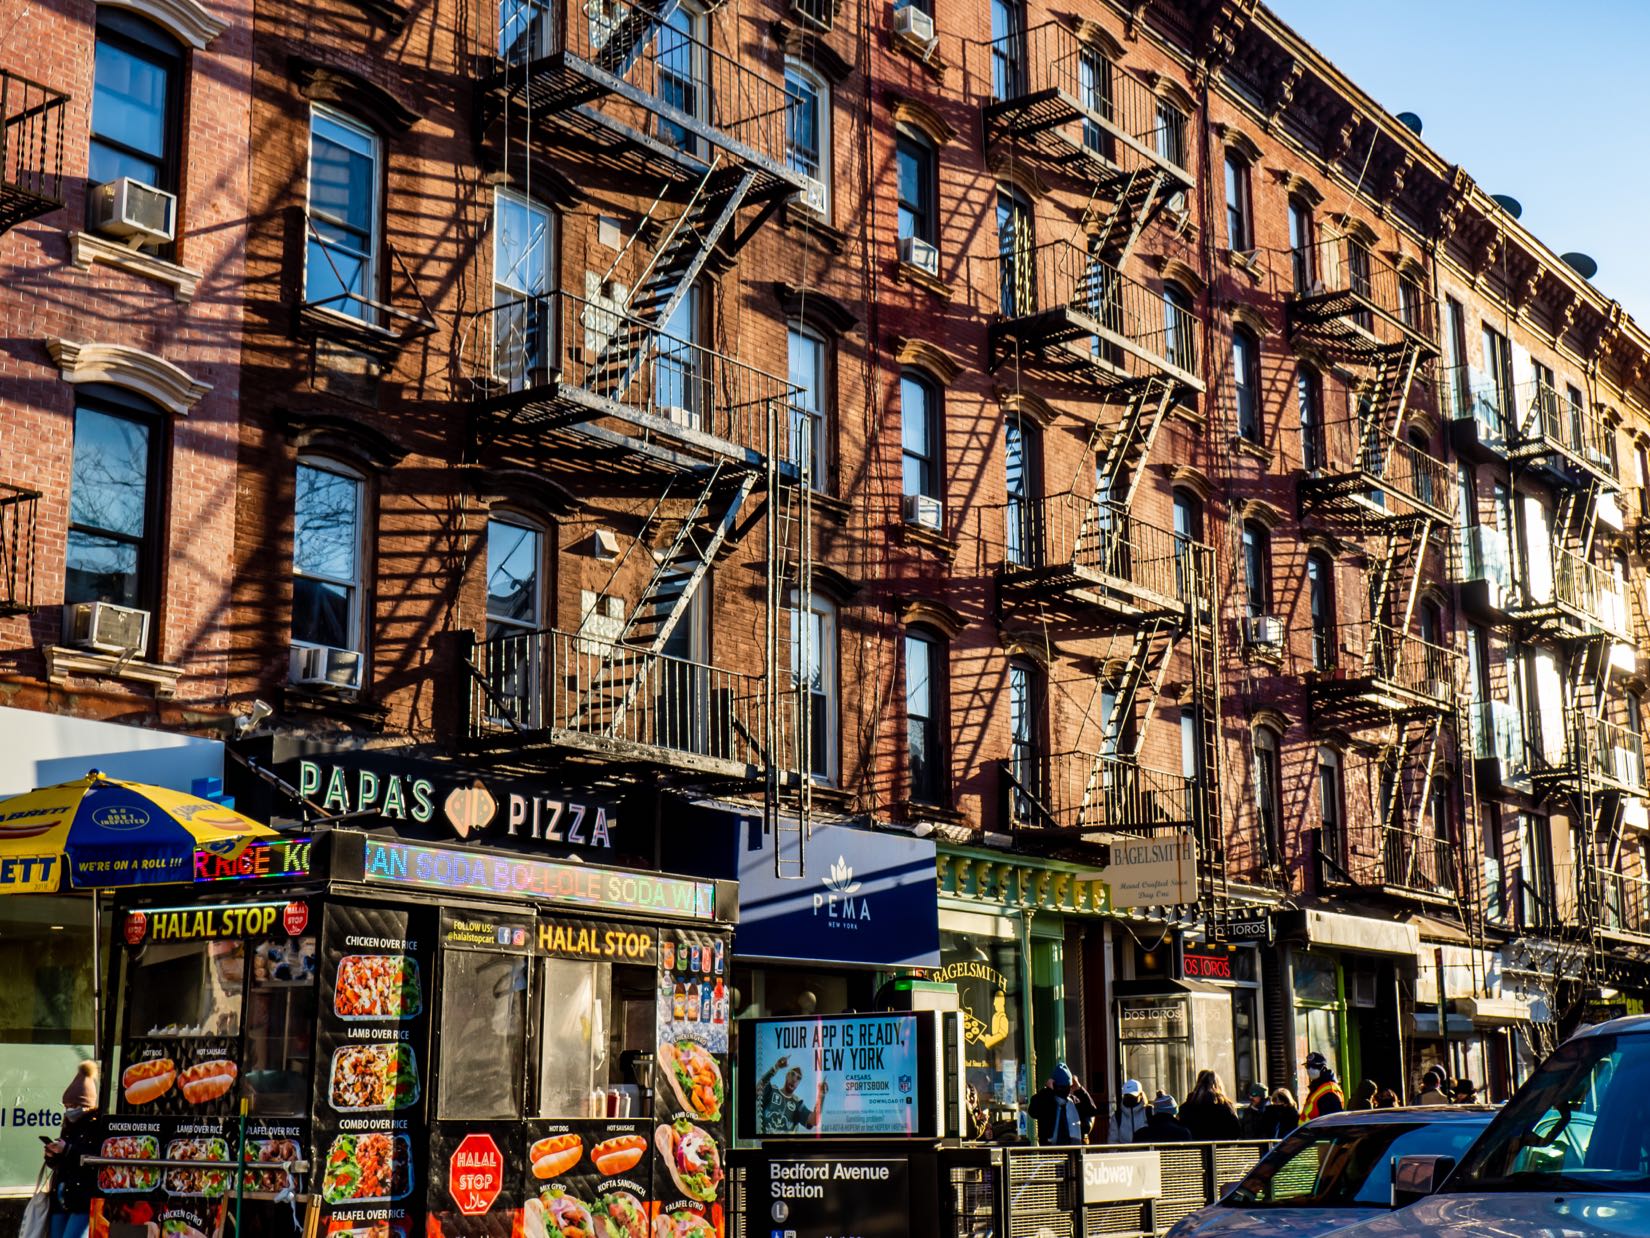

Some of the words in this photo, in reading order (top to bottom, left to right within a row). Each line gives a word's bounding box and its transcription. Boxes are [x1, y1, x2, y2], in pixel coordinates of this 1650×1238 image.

[301, 760, 435, 823] PAPA'S
[508, 793, 611, 848] PIZZA
[1114, 843, 1192, 866] BAGELSMITH
[78, 861, 110, 872] WE'RE
[114, 860, 128, 870] ON
[131, 859, 138, 869] A
[141, 859, 166, 869] ROLL
[416, 853, 487, 887] SODA
[608, 877, 666, 907] SODA
[813, 893, 871, 921] PEMA
[152, 911, 217, 939] HALAL
[221, 907, 277, 935] STOP
[287, 916, 304, 925] STOP
[453, 920, 481, 932] FOLLOW
[843, 922, 858, 930] YORK
[345, 936, 379, 948] CHICKEN
[380, 938, 400, 949] OVER
[401, 940, 418, 950] RICE
[538, 924, 601, 954] HALAL
[604, 931, 651, 957] STOP
[1184, 959, 1198, 975] OS
[1200, 957, 1231, 977] TOROS
[933, 962, 1008, 992] BAGELSMITH
[1124, 1010, 1146, 1021] DOS
[347, 1028, 370, 1039] LAMB
[372, 1029, 392, 1039] OVER
[775, 1026, 806, 1049] YOUR
[812, 1025, 836, 1048] APP
[842, 1025, 853, 1047] IS
[859, 1022, 905, 1047] READY,
[814, 1049, 843, 1071] NEW
[850, 1047, 884, 1071] YORK
[845, 1081, 889, 1091] SPORTSBOOK
[13, 1108, 62, 1127] Bette
[672, 1111, 685, 1120] LAMB
[686, 1111, 699, 1120] GYRO
[108, 1122, 131, 1132] CHICKEN
[132, 1123, 147, 1132] OVER
[148, 1123, 160, 1132] RICE
[177, 1124, 193, 1133] LAMB
[193, 1125, 209, 1134] OVER
[210, 1125, 223, 1134] RICE
[246, 1126, 268, 1135] ALAFEL
[268, 1127, 285, 1136] OVER
[286, 1127, 300, 1136] RICE
[339, 1119, 368, 1129] COMBO
[370, 1119, 391, 1129] OVER
[391, 1119, 408, 1129] RICE
[457, 1152, 497, 1167] HALAL
[770, 1163, 829, 1180] Bedford
[833, 1163, 889, 1180] Avenue
[1084, 1162, 1134, 1187] Subway
[459, 1174, 493, 1190] STOP
[539, 1184, 550, 1192] MIX
[551, 1183, 567, 1192] GYRO
[597, 1180, 617, 1193] KOFTA
[617, 1179, 647, 1197] SANDWICH
[770, 1181, 824, 1198] Station
[464, 1192, 488, 1209] حلال
[665, 1200, 688, 1213] FALAFEL
[688, 1201, 704, 1211] GYRO
[332, 1211, 365, 1221] FALAFEL
[367, 1209, 388, 1219] OVER
[388, 1208, 405, 1219] RICE
[776, 1204, 785, 1218] L
[186, 1211, 203, 1227] GYRO
